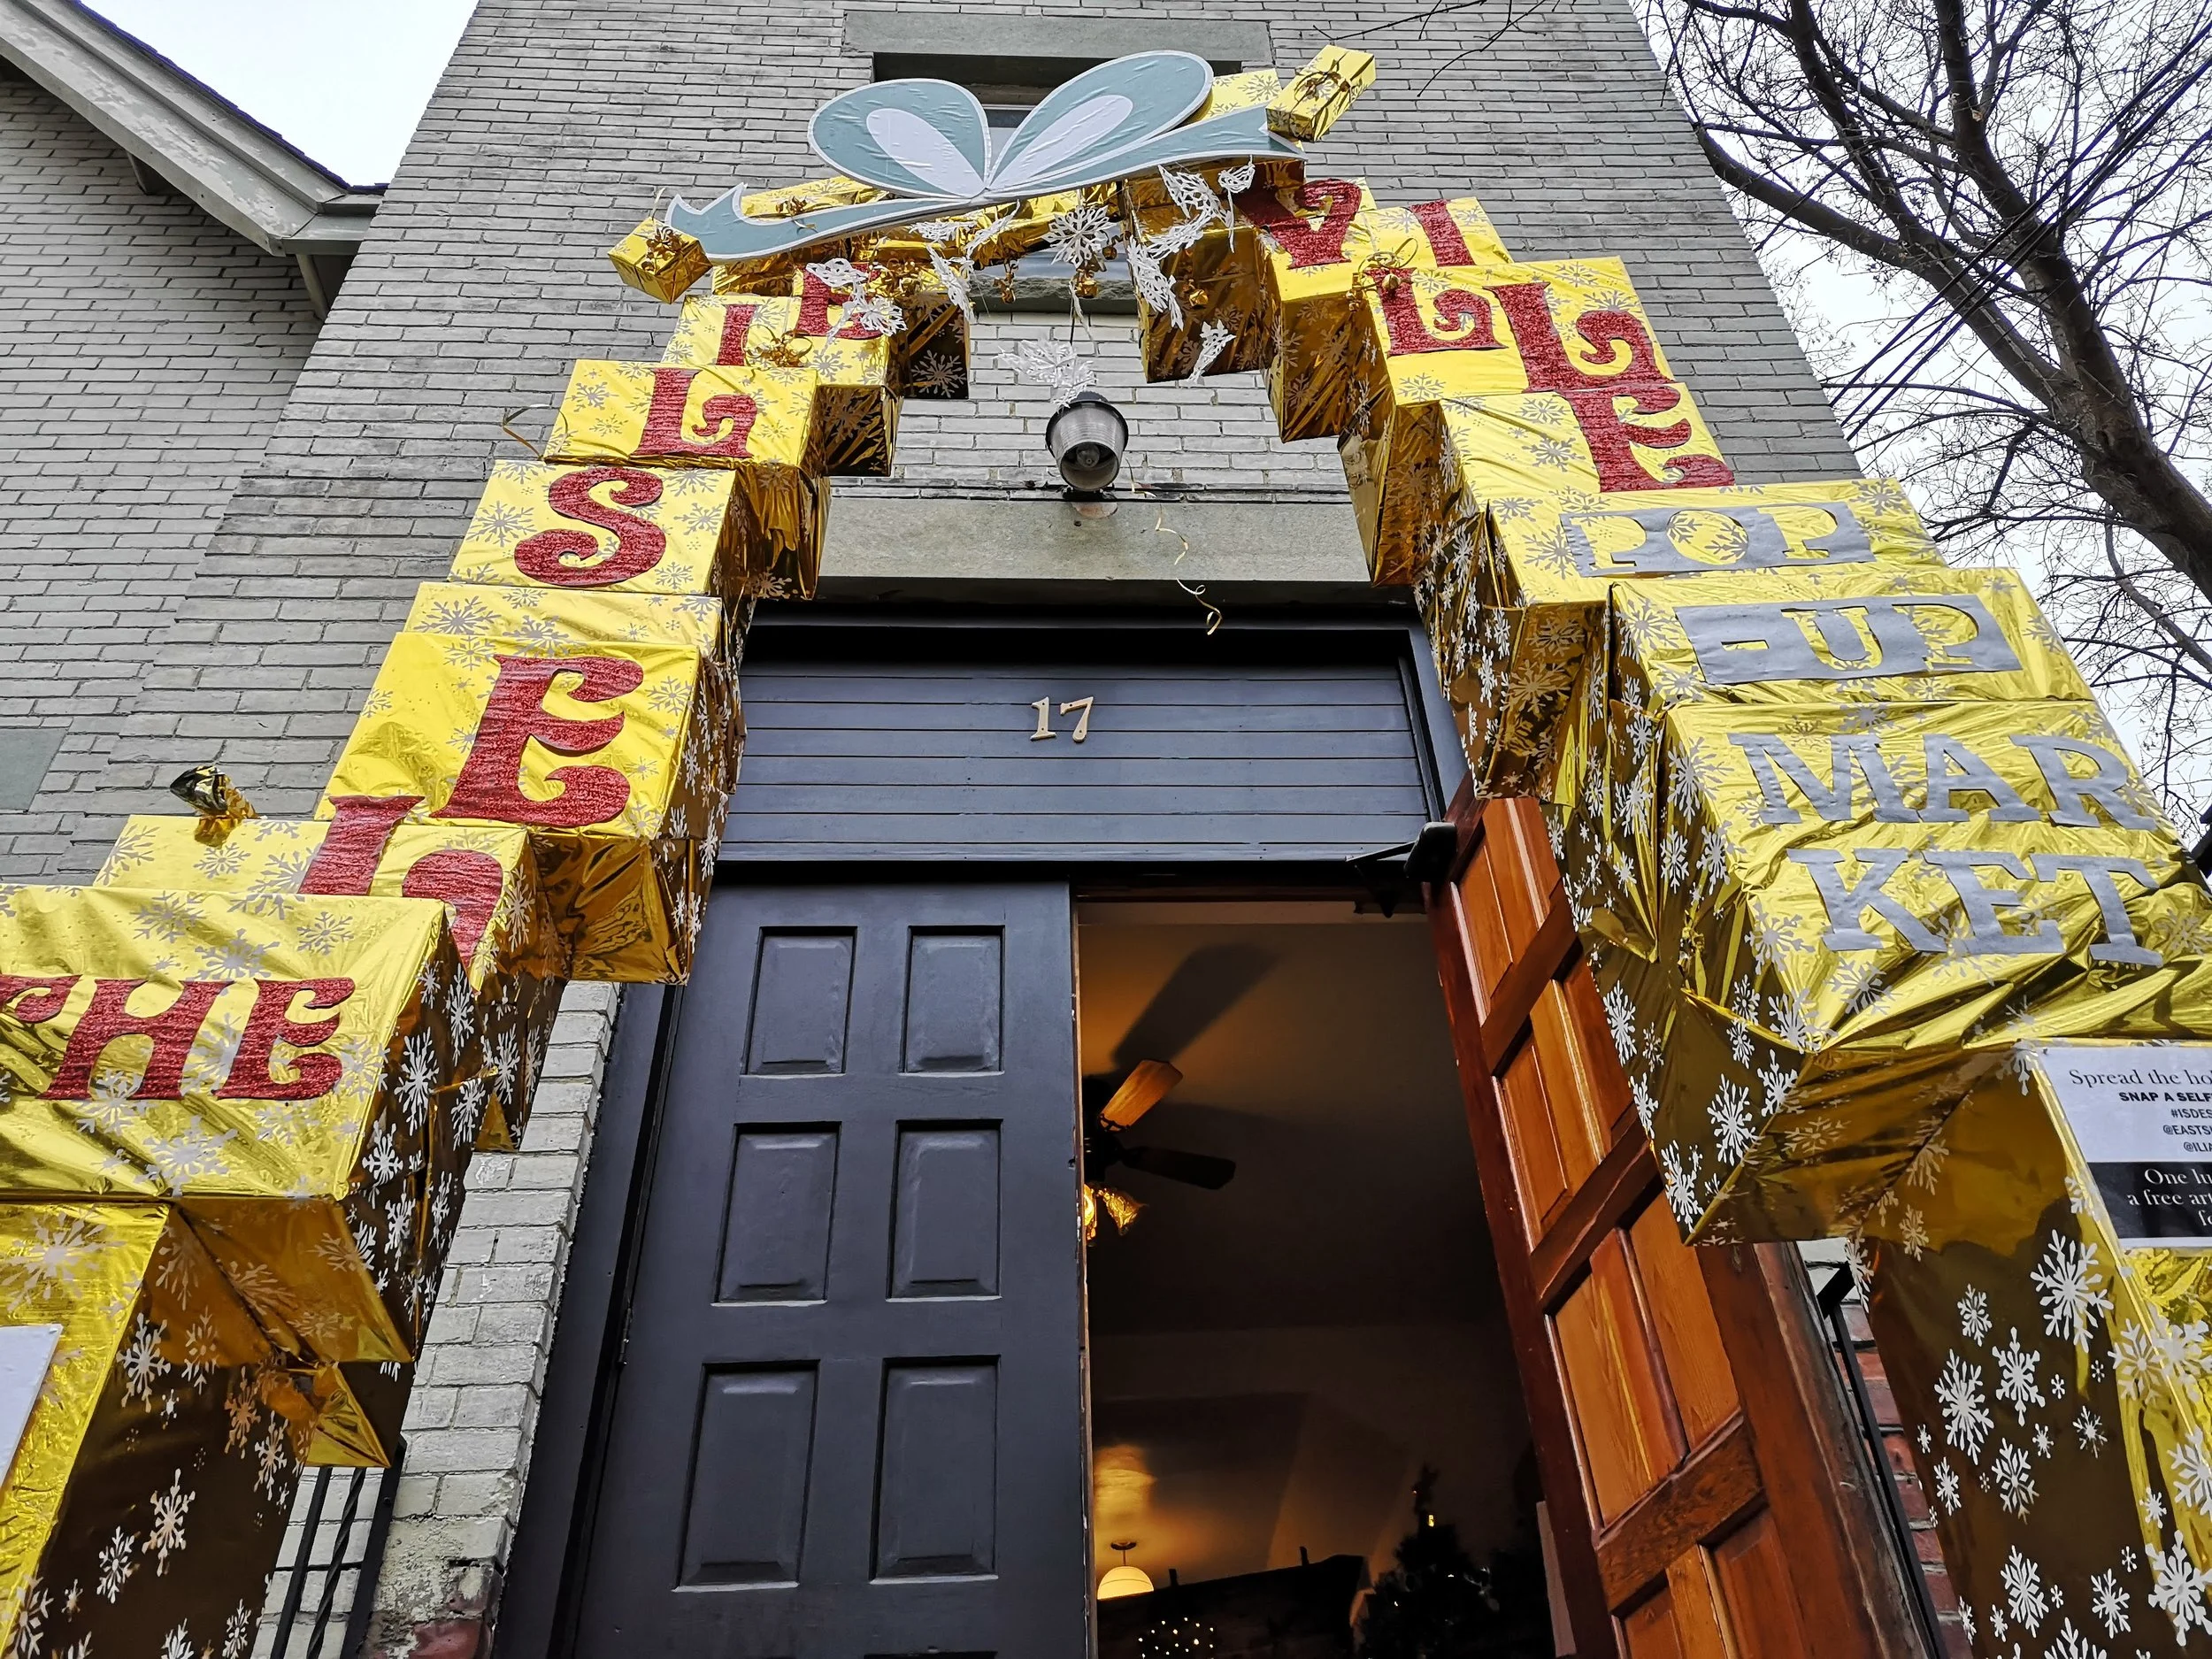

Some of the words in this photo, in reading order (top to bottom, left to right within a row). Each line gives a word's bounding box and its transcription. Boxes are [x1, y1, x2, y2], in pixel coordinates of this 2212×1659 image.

[1570, 502, 1839, 567] POP
[1030, 695, 1094, 742] 17
[1728, 732, 2160, 831] MAR
[1786, 847, 2164, 968] KET
[2069, 1069, 2144, 1088] Spread
[2147, 1069, 2182, 1085] the
[2183, 1069, 2212, 1085] ho
[2118, 1092, 2159, 1102] SNAP
[2164, 1093, 2175, 1102] A
[2177, 1092, 2212, 1102] SELF
[2144, 1168, 2189, 1185] One
[2127, 1194, 2140, 1205] a
[2143, 1189, 2185, 1205] free
